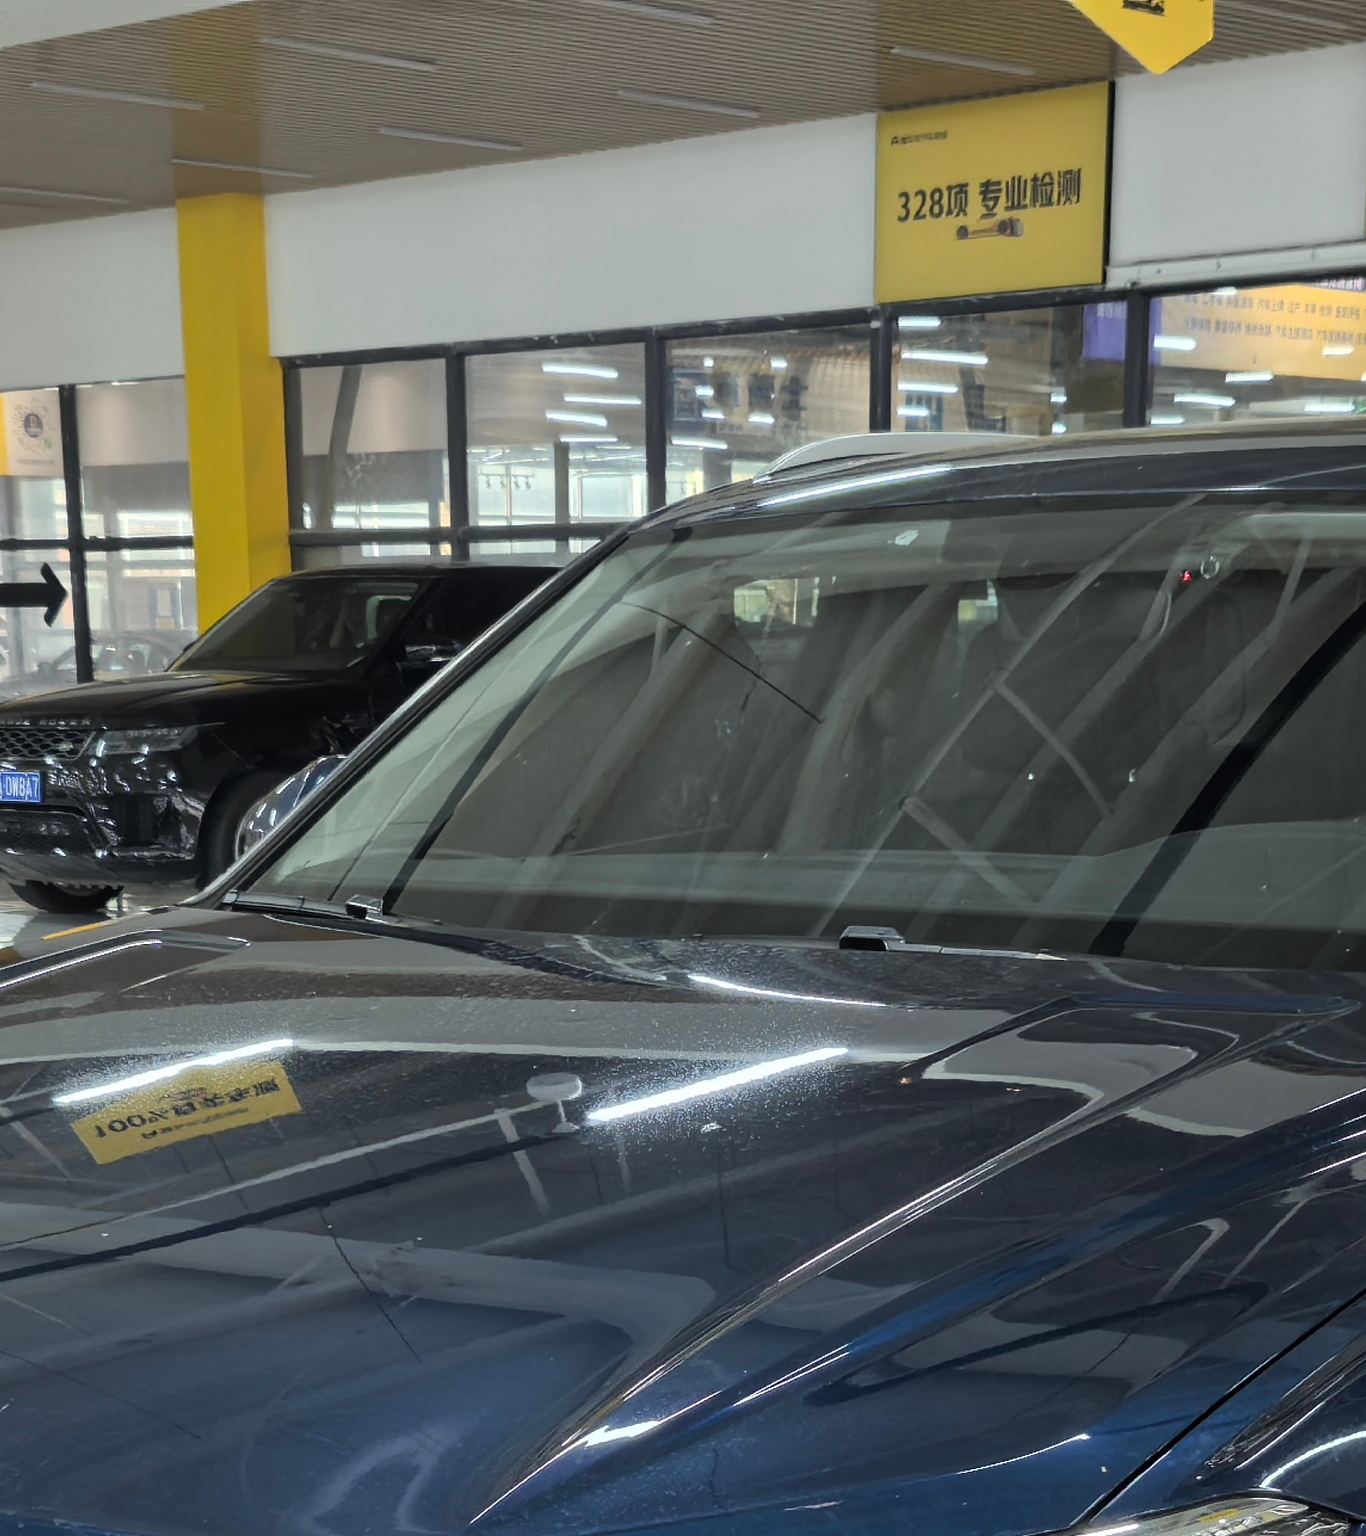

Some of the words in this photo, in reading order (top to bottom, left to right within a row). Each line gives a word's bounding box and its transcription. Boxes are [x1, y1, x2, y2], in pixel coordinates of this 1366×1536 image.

[897, 183, 969, 223] 328项
[978, 168, 1082, 221] 专业检测
